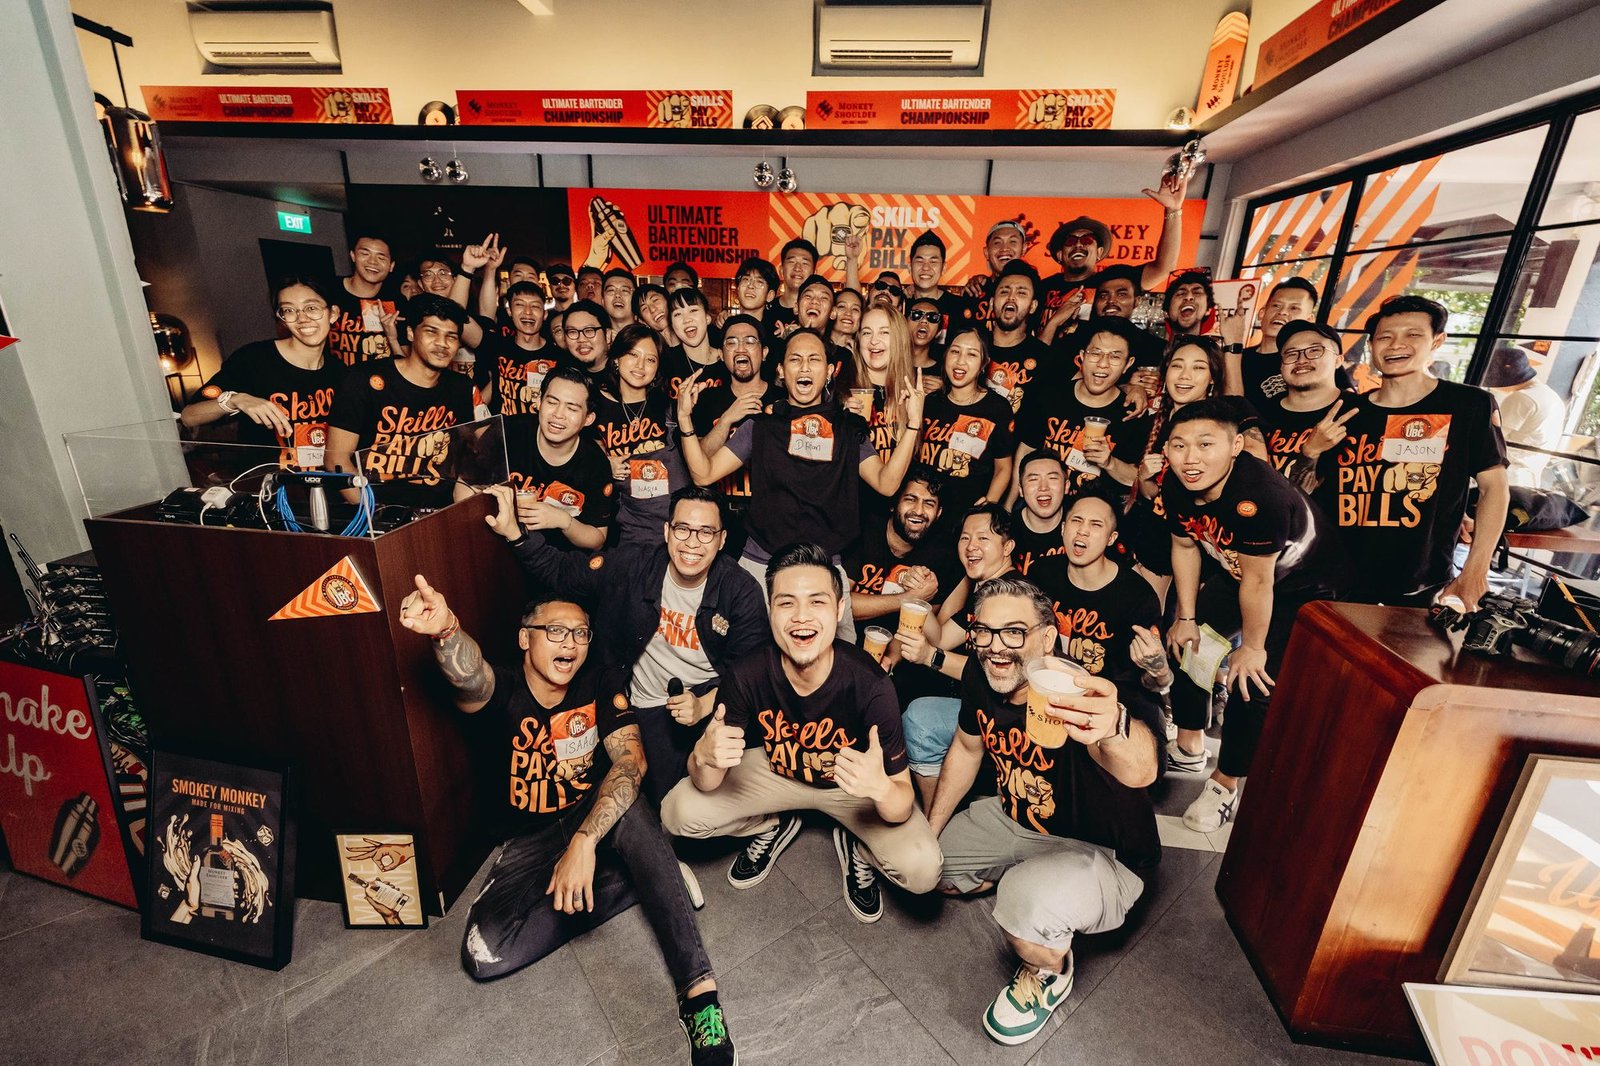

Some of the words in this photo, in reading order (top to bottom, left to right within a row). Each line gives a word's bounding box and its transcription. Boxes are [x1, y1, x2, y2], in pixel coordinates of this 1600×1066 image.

[218, 93, 252, 104] ULTIMATE
[252, 94, 293, 104] BARTENDER
[352, 92, 382, 103] SKILLS
[542, 98, 578, 109] ULTIMATE
[580, 98, 623, 109] BARTENDER
[690, 95, 724, 107] SKILLS
[901, 98, 941, 110] ULTIMATE
[942, 98, 992, 110] BARTENDER
[1066, 94, 1105, 107] SKILLS
[690, 106, 709, 116] PAY
[838, 102, 873, 110] MONKEY
[1065, 106, 1087, 117] PAY
[544, 111, 623, 123] CHAMPIONSHIP
[690, 117, 718, 127] BILLS
[834, 110, 877, 119] SHOULDER
[901, 111, 990, 124] CHAMPIONSHIP
[1064, 117, 1095, 128] BILLS
[285, 215, 304, 230] EXIT
[648, 204, 723, 225] ULTIMATE
[870, 205, 941, 229] SKILLS
[648, 225, 739, 247] BARTENDER
[870, 228, 908, 248] PAY
[649, 246, 760, 265] CHAMPIONSHIP
[869, 249, 911, 270] BILL
[377, 405, 457, 433] Skills
[598, 418, 666, 449] kills
[370, 433, 418, 456] PAY
[1395, 444, 1437, 456] JASON
[920, 442, 941, 466] AY
[1338, 464, 1382, 493] PAY
[1338, 492, 1421, 528] BILLS
[510, 750, 556, 781] PAY
[171, 778, 218, 800] SMOKEY
[220, 786, 267, 809] MONKEY
[510, 775, 580, 814] BILL
[191, 798, 208, 807] MADE
[209, 801, 222, 811] FOR
[223, 804, 245, 815] MIXING
